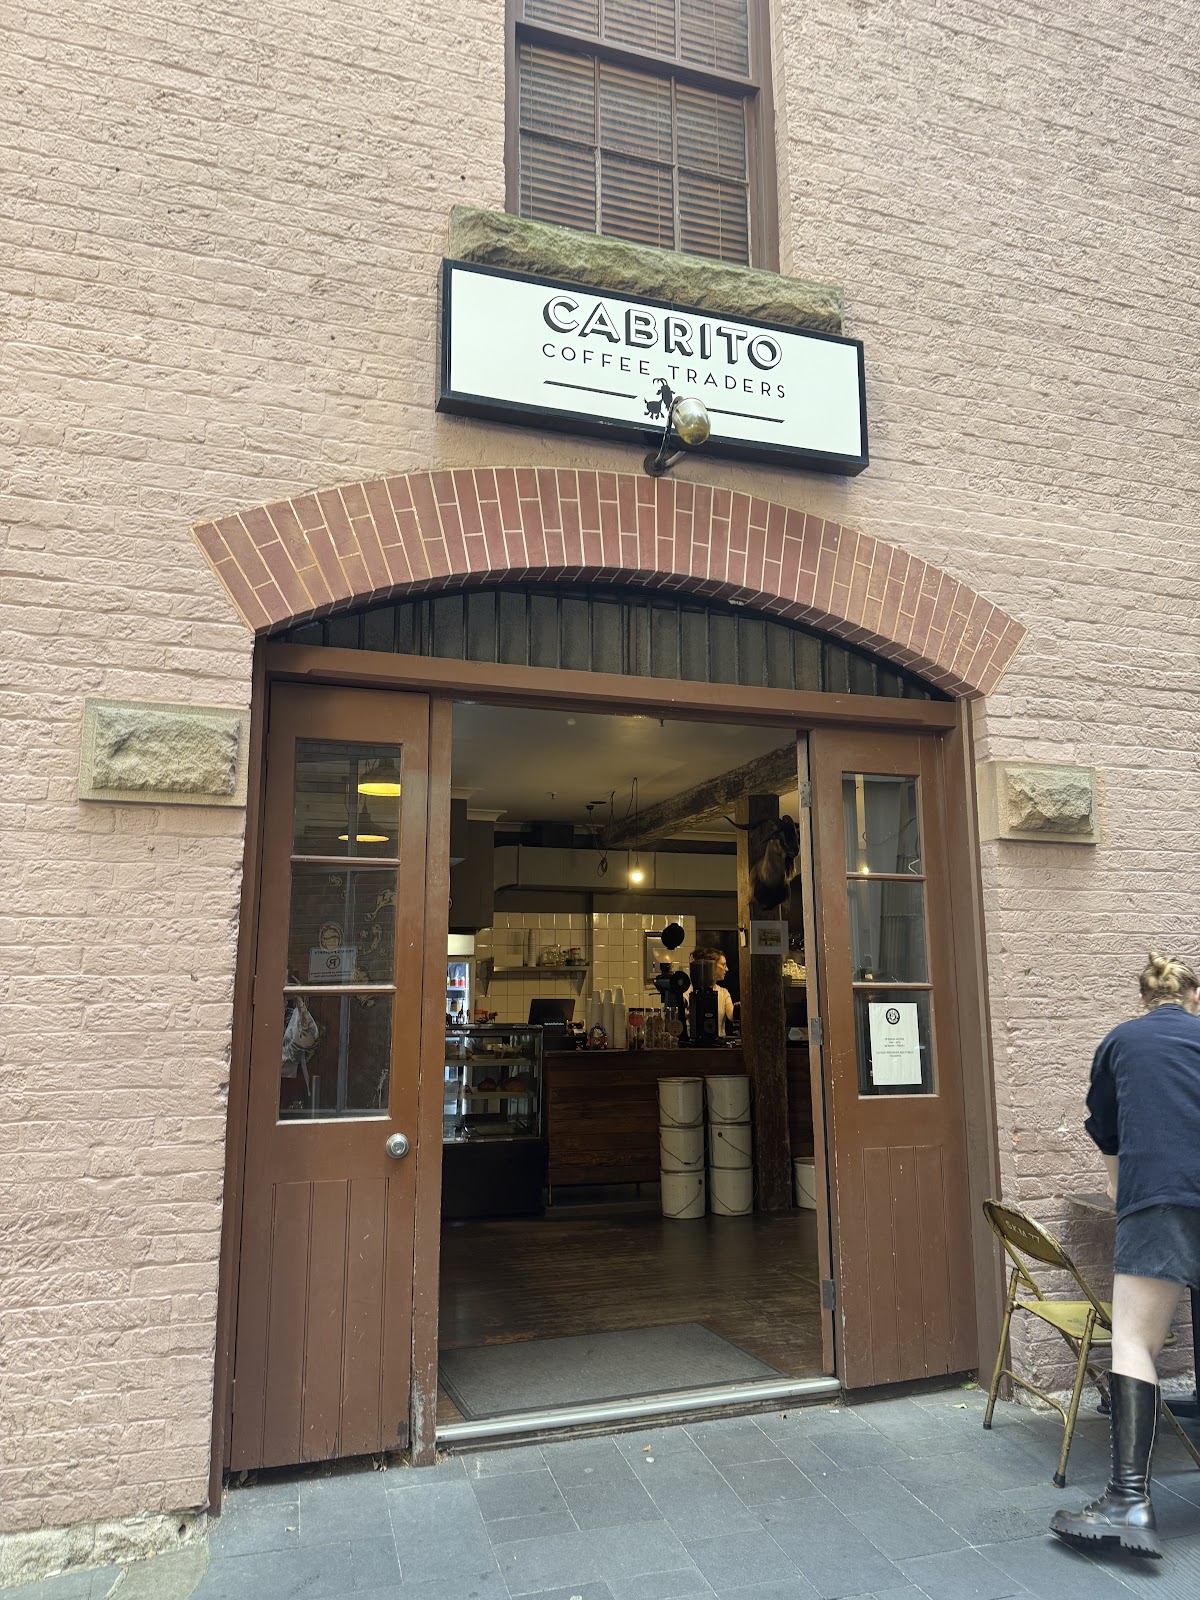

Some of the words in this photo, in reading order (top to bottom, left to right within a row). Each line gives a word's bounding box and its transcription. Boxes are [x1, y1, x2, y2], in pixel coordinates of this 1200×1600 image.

[543, 295, 782, 371] CABRITO
[542, 343, 650, 376] COFFEE
[668, 364, 785, 399] TRADERS
